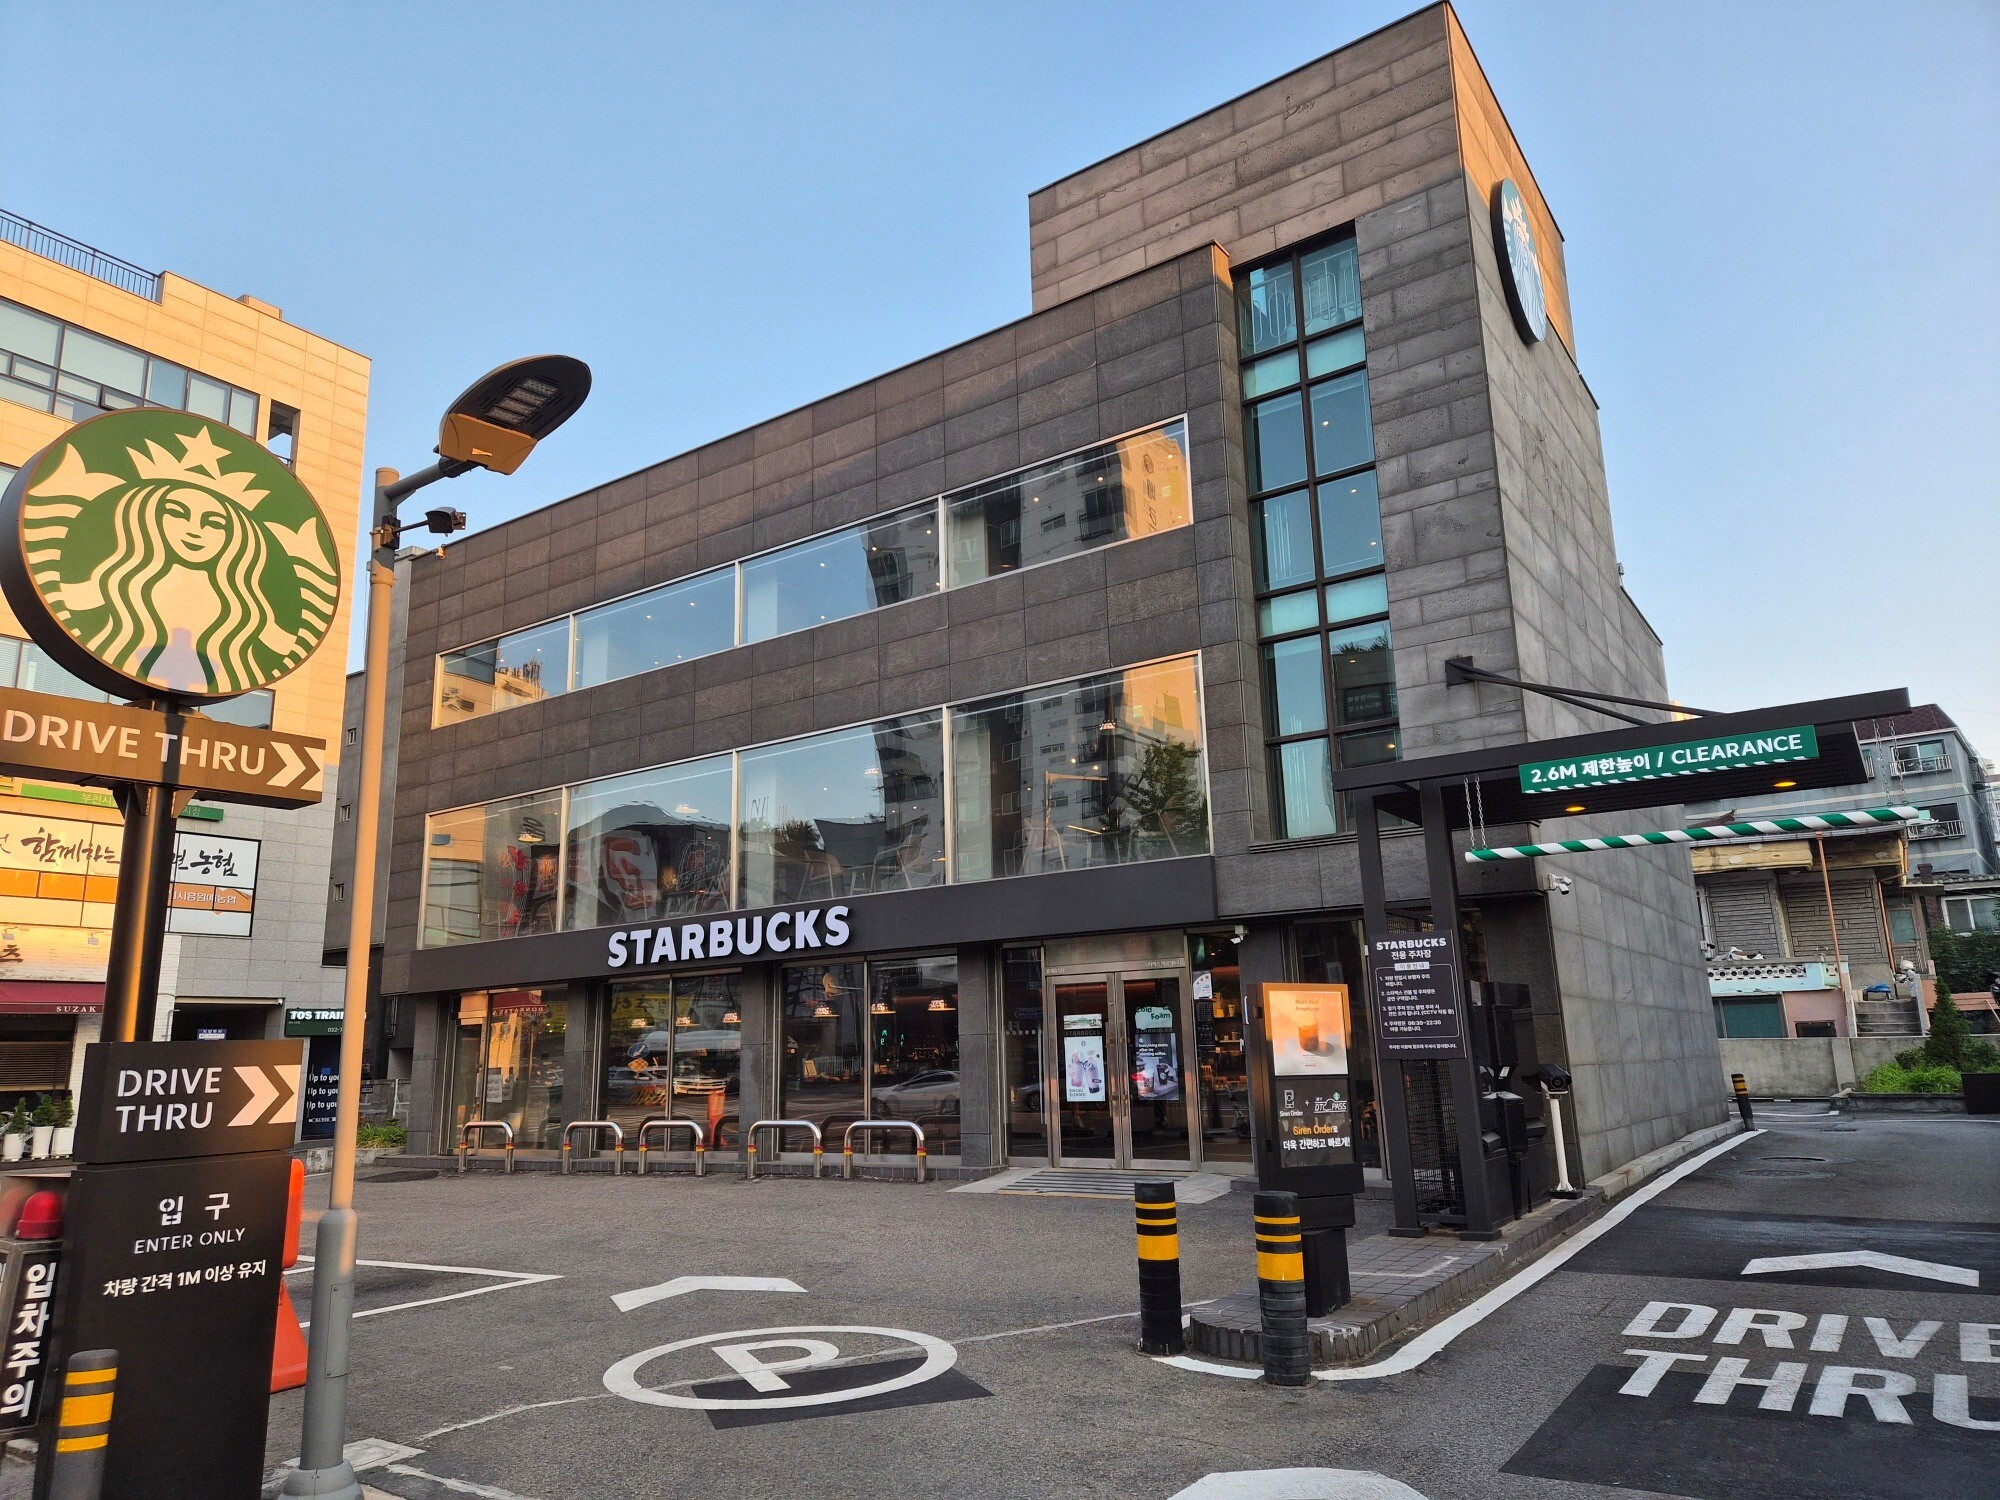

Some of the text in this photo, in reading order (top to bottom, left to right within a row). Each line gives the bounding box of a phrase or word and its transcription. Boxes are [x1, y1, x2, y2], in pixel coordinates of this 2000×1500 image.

[3, 709, 266, 775] DRIVE THRU
[1531, 733, 1804, 784] 2.6M 제한높이 / CLEARANCE
[82, 793, 116, 806] 부천시
[20, 827, 120, 864] 함께하는
[190, 848, 239, 877] 농협
[607, 905, 851, 968] STARBUCKS
[1376, 937, 1447, 951] STARBUCKS
[1391, 949, 1432, 960] 전용 주차장
[56, 1005, 97, 1013] SUZAK
[290, 1010, 313, 1020] TOS
[117, 1067, 222, 1097] DRIVE
[115, 1101, 213, 1133] THRU
[1291, 1109, 1303, 1117] Order
[1331, 1102, 1347, 1111] PASS
[1283, 1139, 1297, 1150] 더욱
[1299, 1138, 1327, 1150] 간편하고
[1293, 1125, 1312, 1136] Siren
[134, 1227, 246, 1254] ENTER ONLY
[103, 1259, 267, 1298] 차량 간격 1M 이상 유지
[1, 1261, 57, 1419] 입차주의
[1621, 1301, 2000, 1363] DRIVE
[711, 1338, 839, 1393] P
